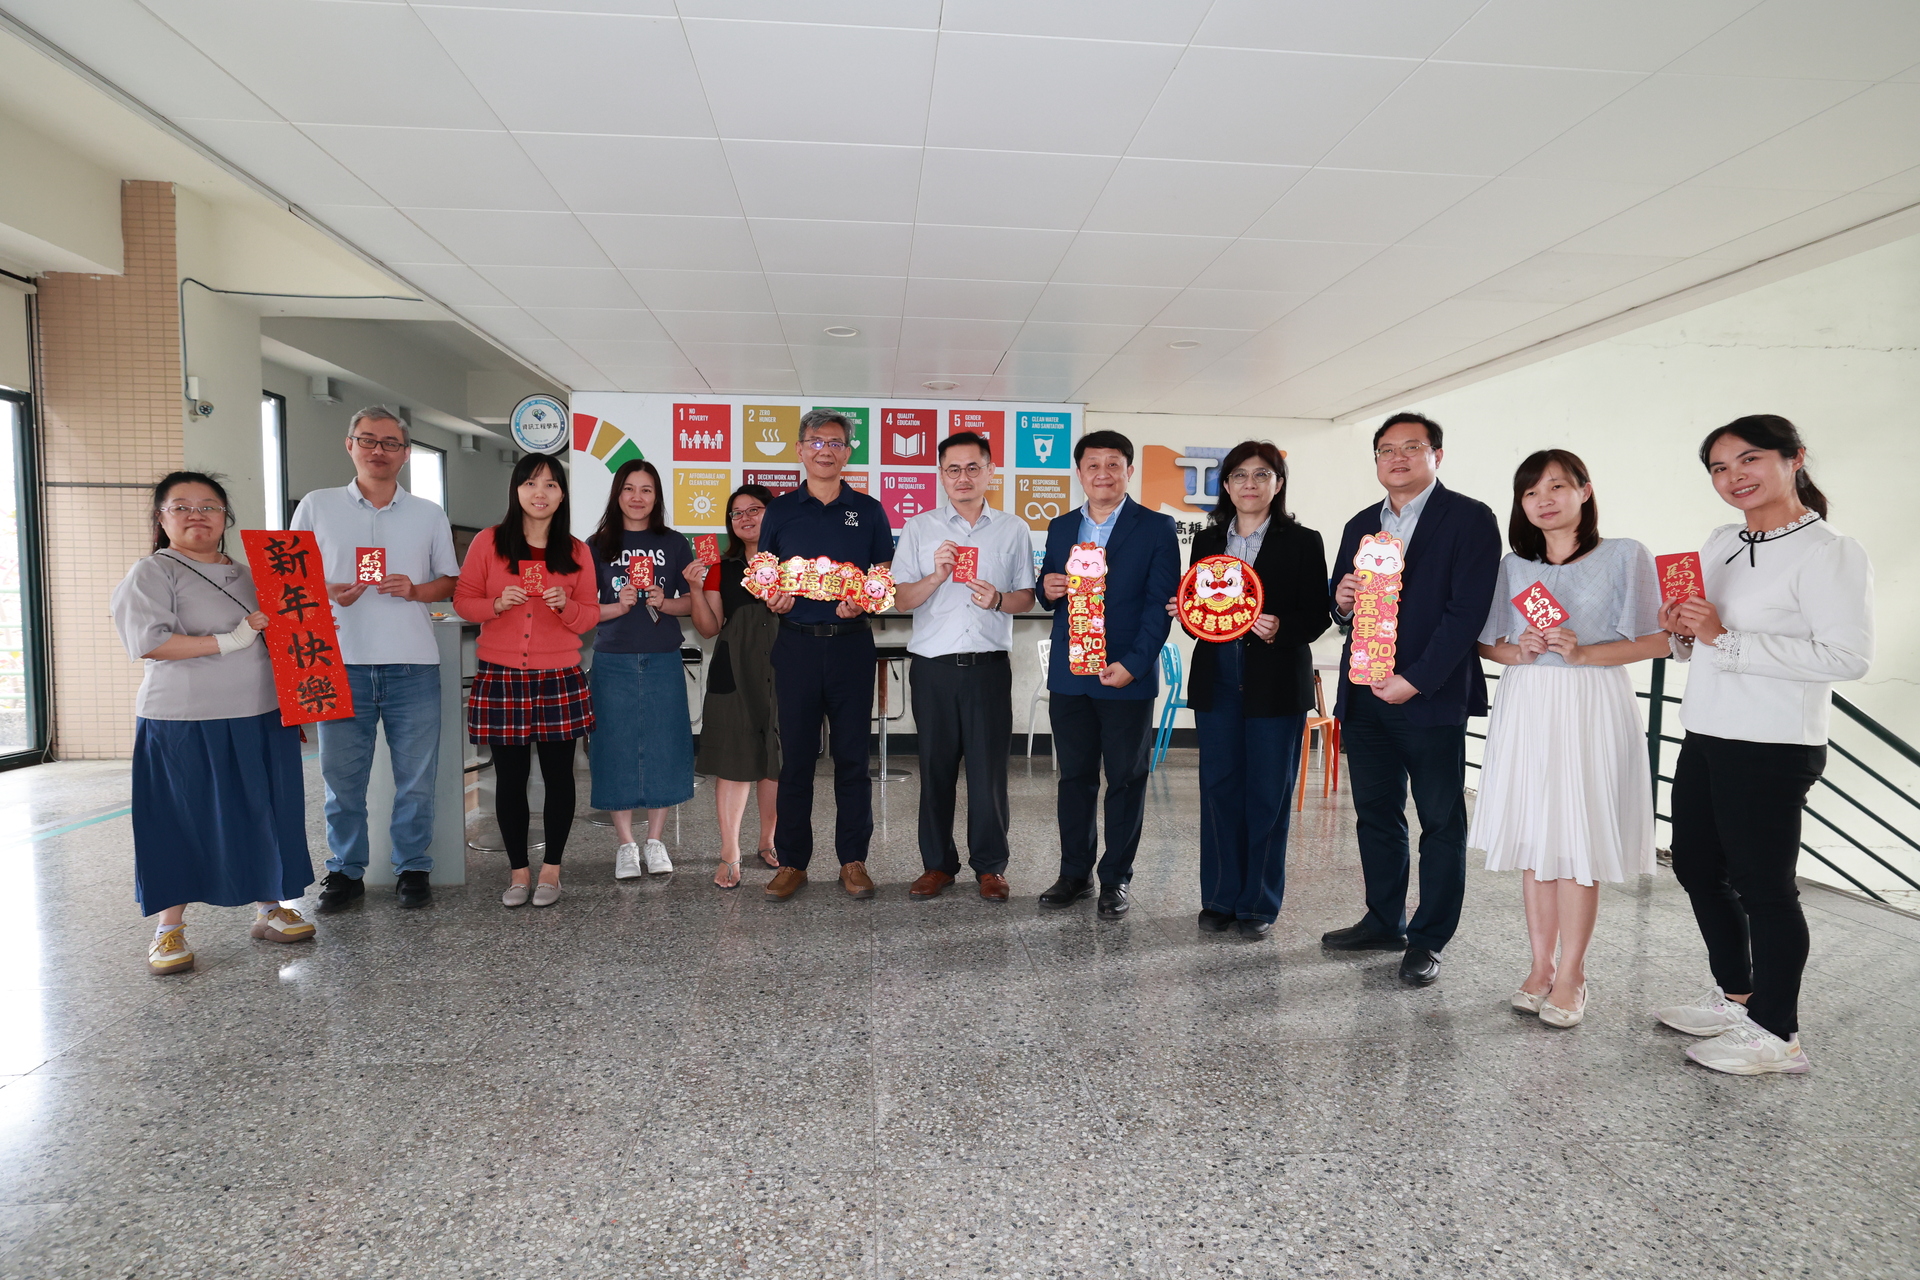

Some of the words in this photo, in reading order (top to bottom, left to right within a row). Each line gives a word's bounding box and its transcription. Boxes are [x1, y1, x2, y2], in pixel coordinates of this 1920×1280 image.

[679, 408, 684, 420] 1
[748, 409, 754, 422] 2
[886, 413, 893, 425] 4
[954, 414, 960, 426] 5
[1021, 416, 1028, 428] 6
[678, 473, 684, 485] 7
[748, 474, 754, 485] 8
[884, 476, 895, 489] 10
[1019, 479, 1030, 491] 12
[1182, 536, 1192, 544] of
[780, 571, 863, 600] 五福臨門
[1666, 579, 1685, 589] 2026
[264, 535, 337, 713] 新年快樂
[1188, 608, 1252, 632] 恭喜發財
[1072, 595, 1104, 673] 萬事如意
[1356, 594, 1392, 682] 萬事如意
